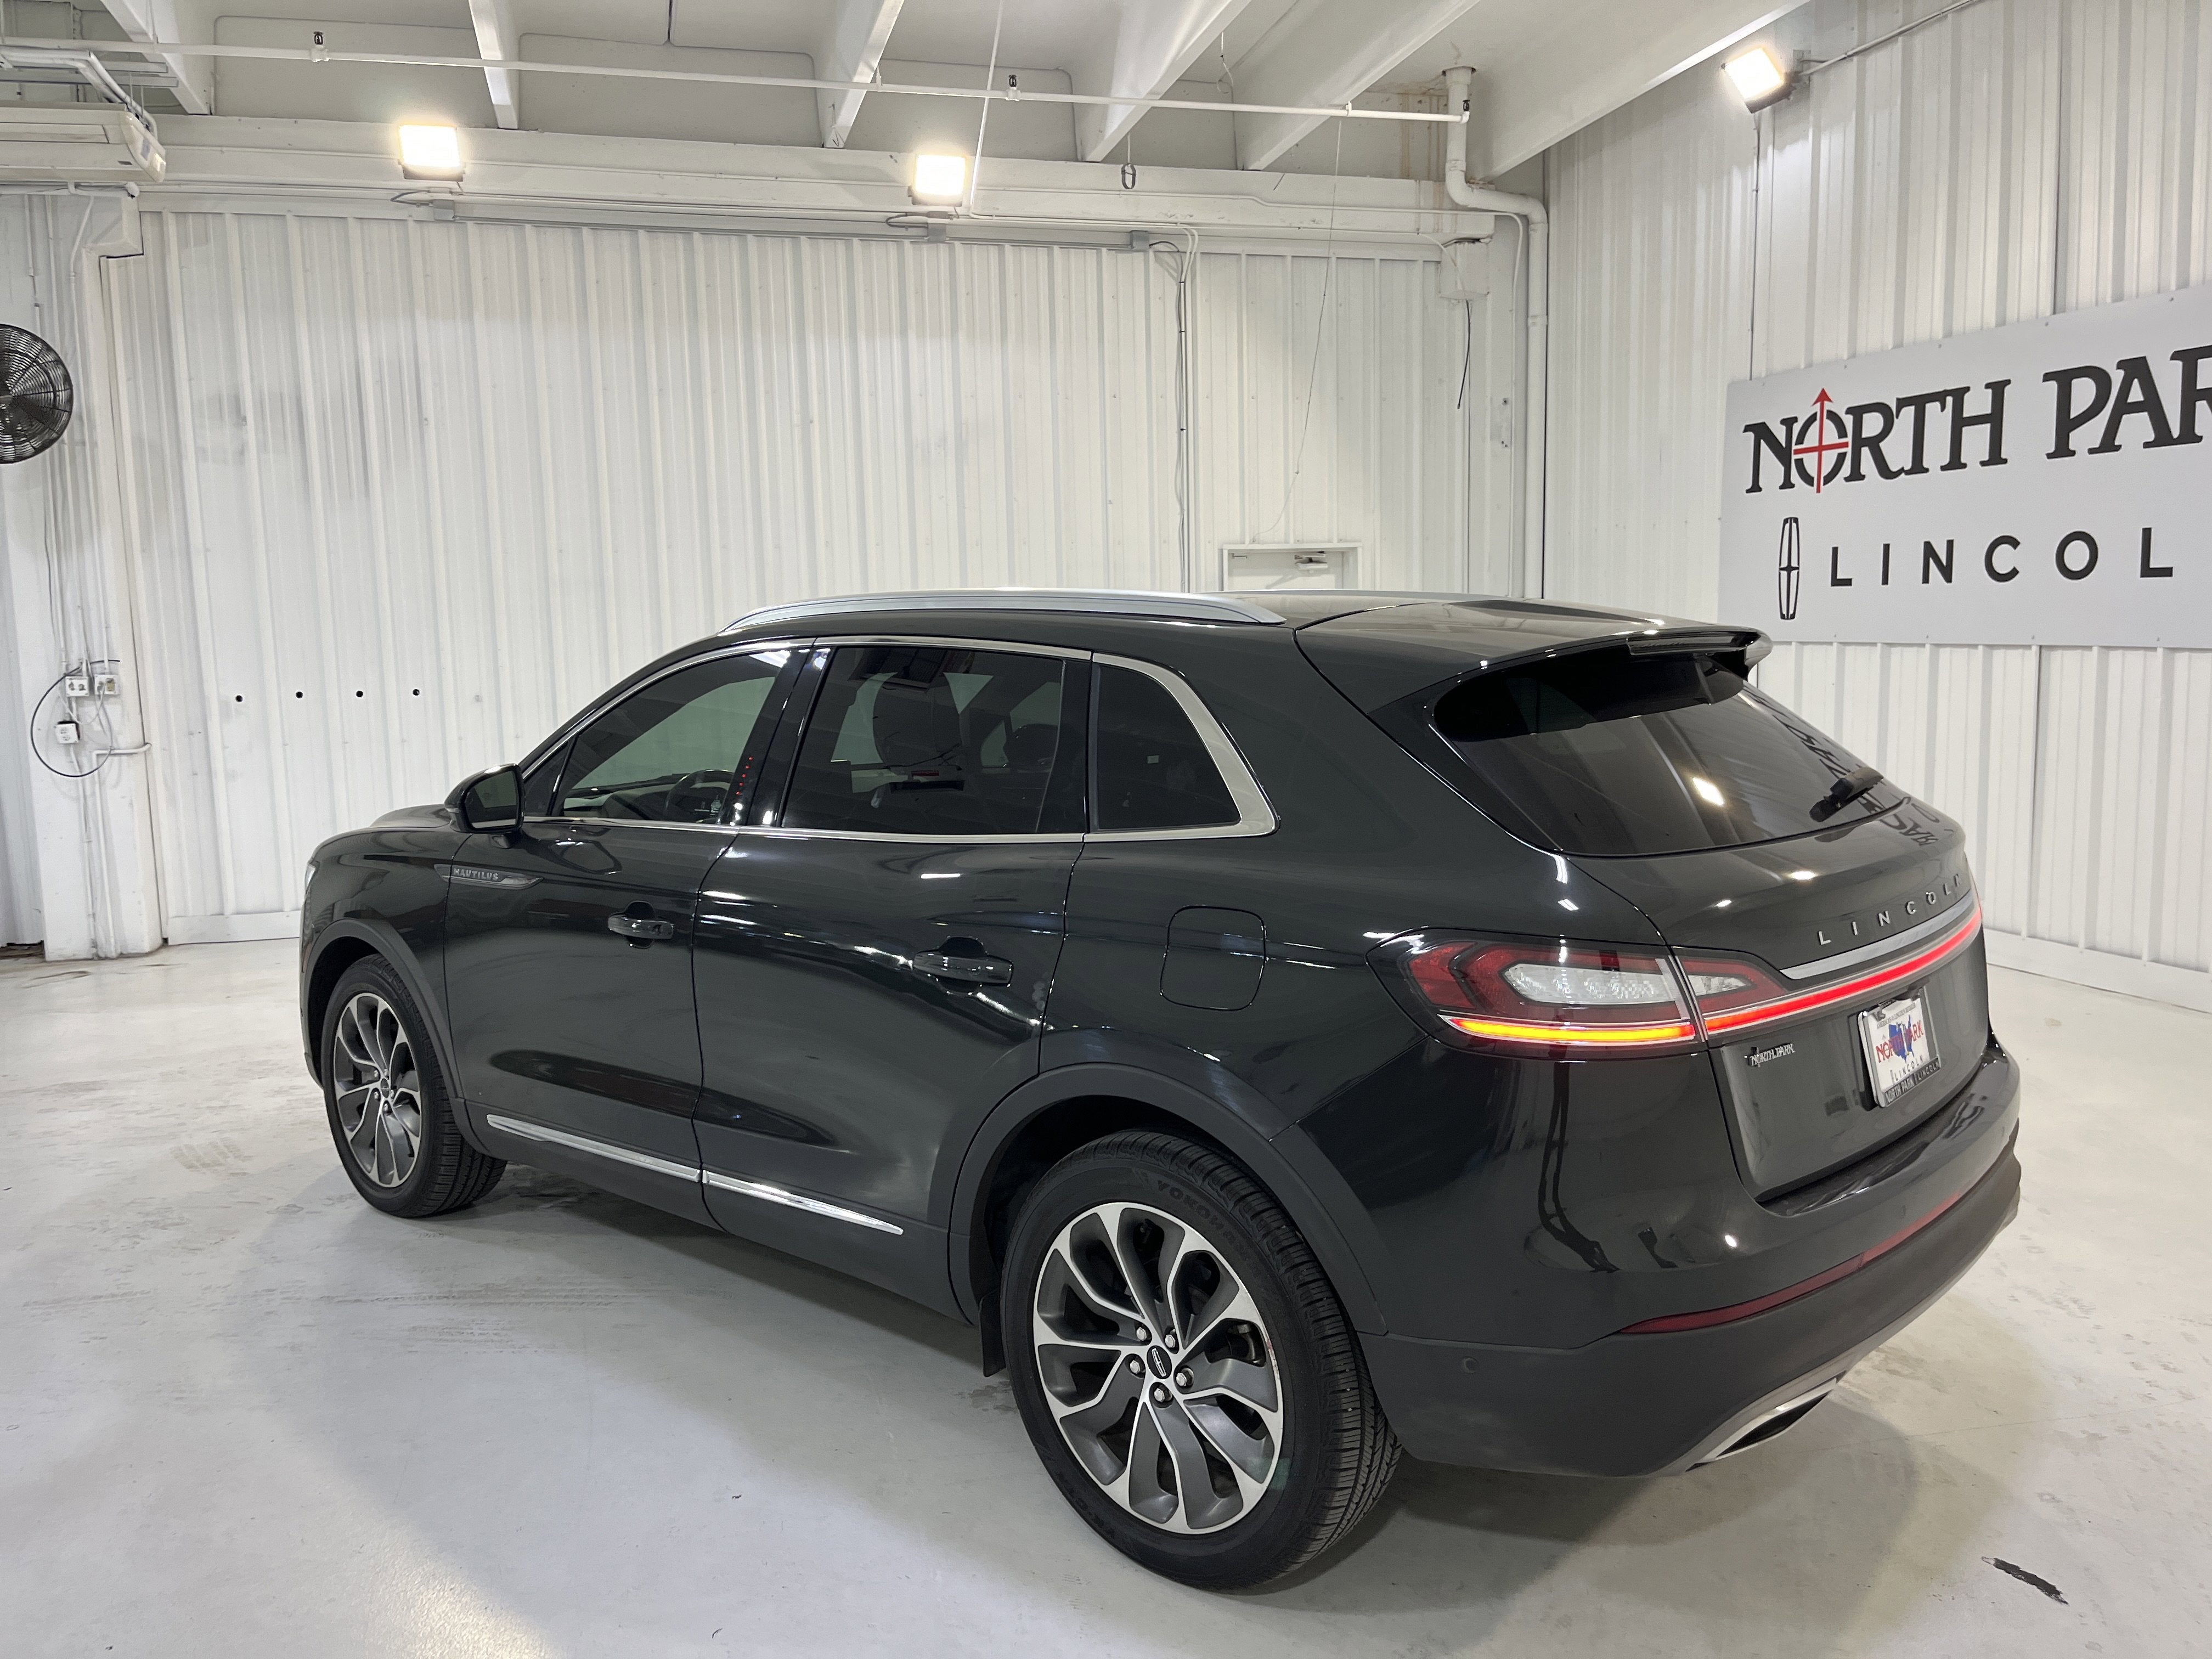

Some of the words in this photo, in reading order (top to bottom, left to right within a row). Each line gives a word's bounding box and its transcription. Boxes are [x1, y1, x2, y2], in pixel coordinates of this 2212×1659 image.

[1742, 379, 2012, 494] NORTH
[1830, 527, 2174, 587] LINCOL
[453, 868, 498, 881] NAUTILUS
[1750, 1047, 1775, 1067] NORTH
[1774, 1043, 1795, 1058] PARK
[1894, 1055, 1923, 1081] LINCOLN
